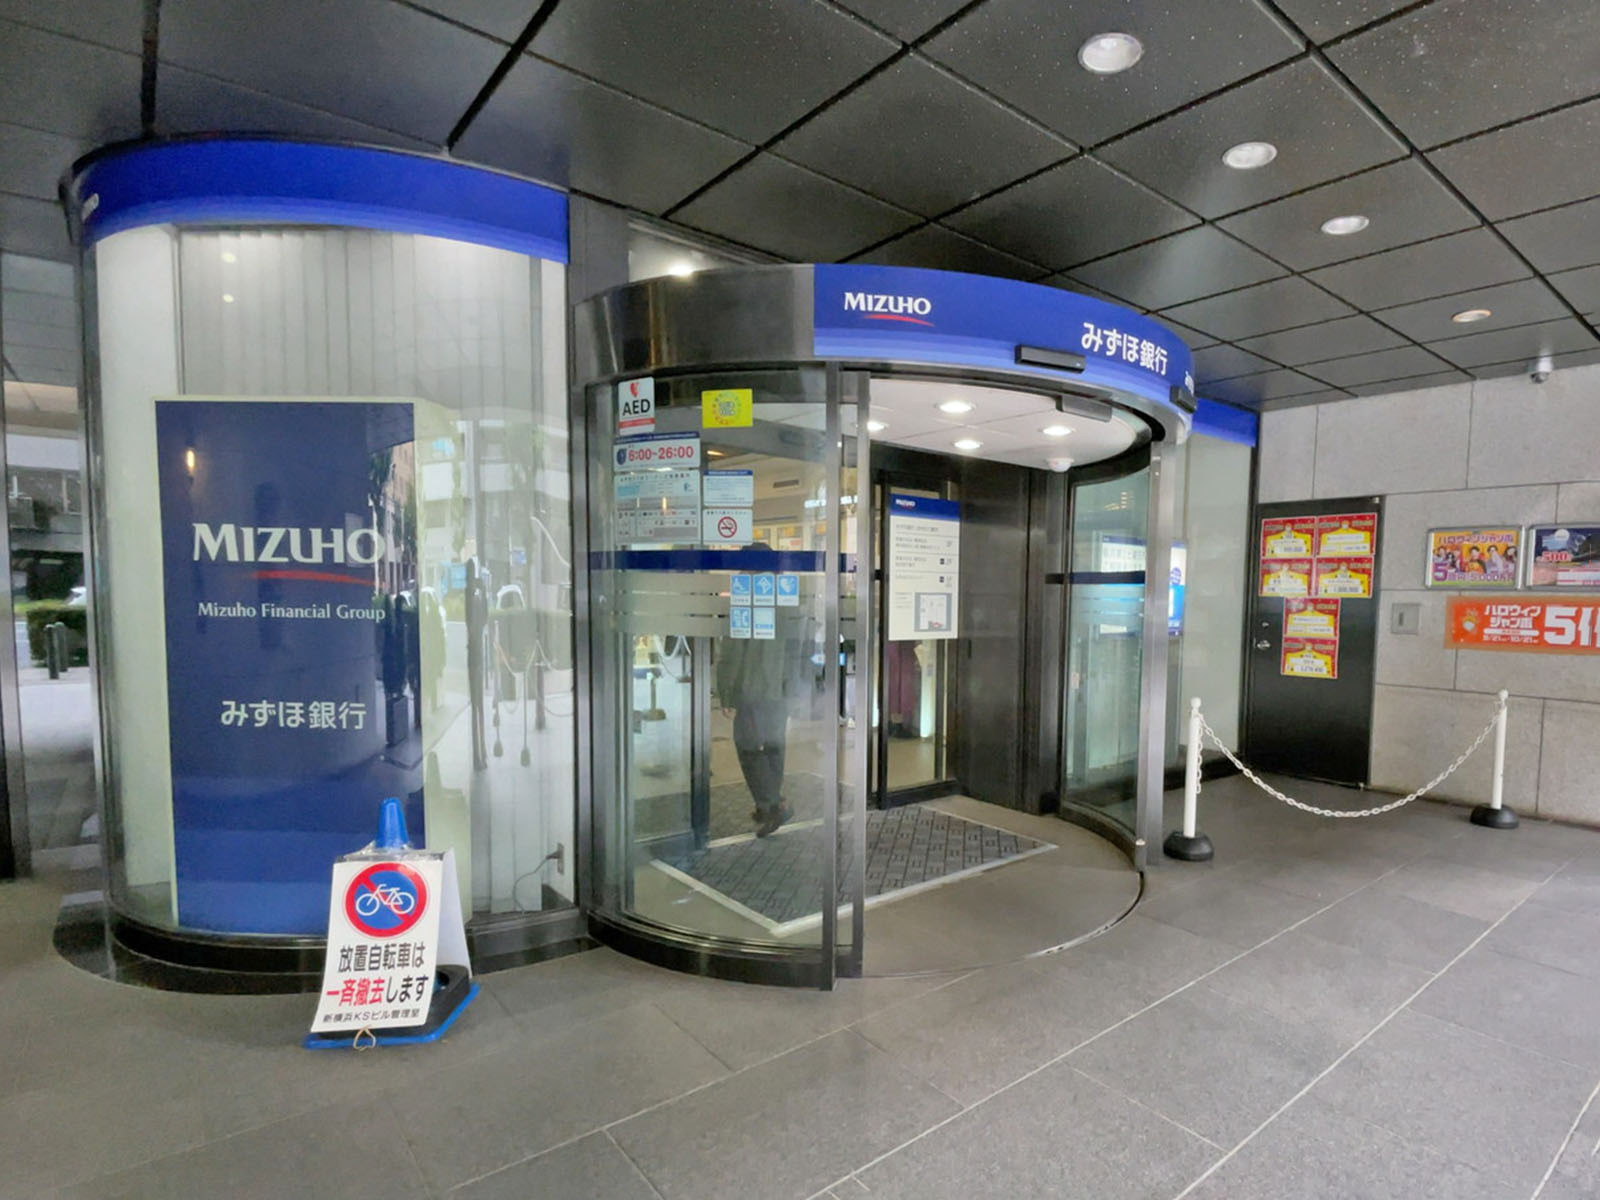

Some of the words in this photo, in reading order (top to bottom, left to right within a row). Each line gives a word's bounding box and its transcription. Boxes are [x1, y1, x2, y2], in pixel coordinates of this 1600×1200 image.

[844, 291, 932, 315] MIZUHO
[1080, 322, 1168, 376] みずほ銀行
[622, 399, 650, 416] AED
[193, 523, 385, 563] MIZUHO
[197, 602, 256, 618] Mizuho
[261, 604, 331, 620] Financial
[335, 604, 386, 623] Group
[1484, 605, 1541, 616] ハロウィン
[220, 700, 367, 729] みずほ銀行
[339, 942, 425, 973] 放置自転車は
[326, 975, 429, 1007] 一斉撤去します
[323, 1009, 420, 1023] 新横浜KSビル管理室
